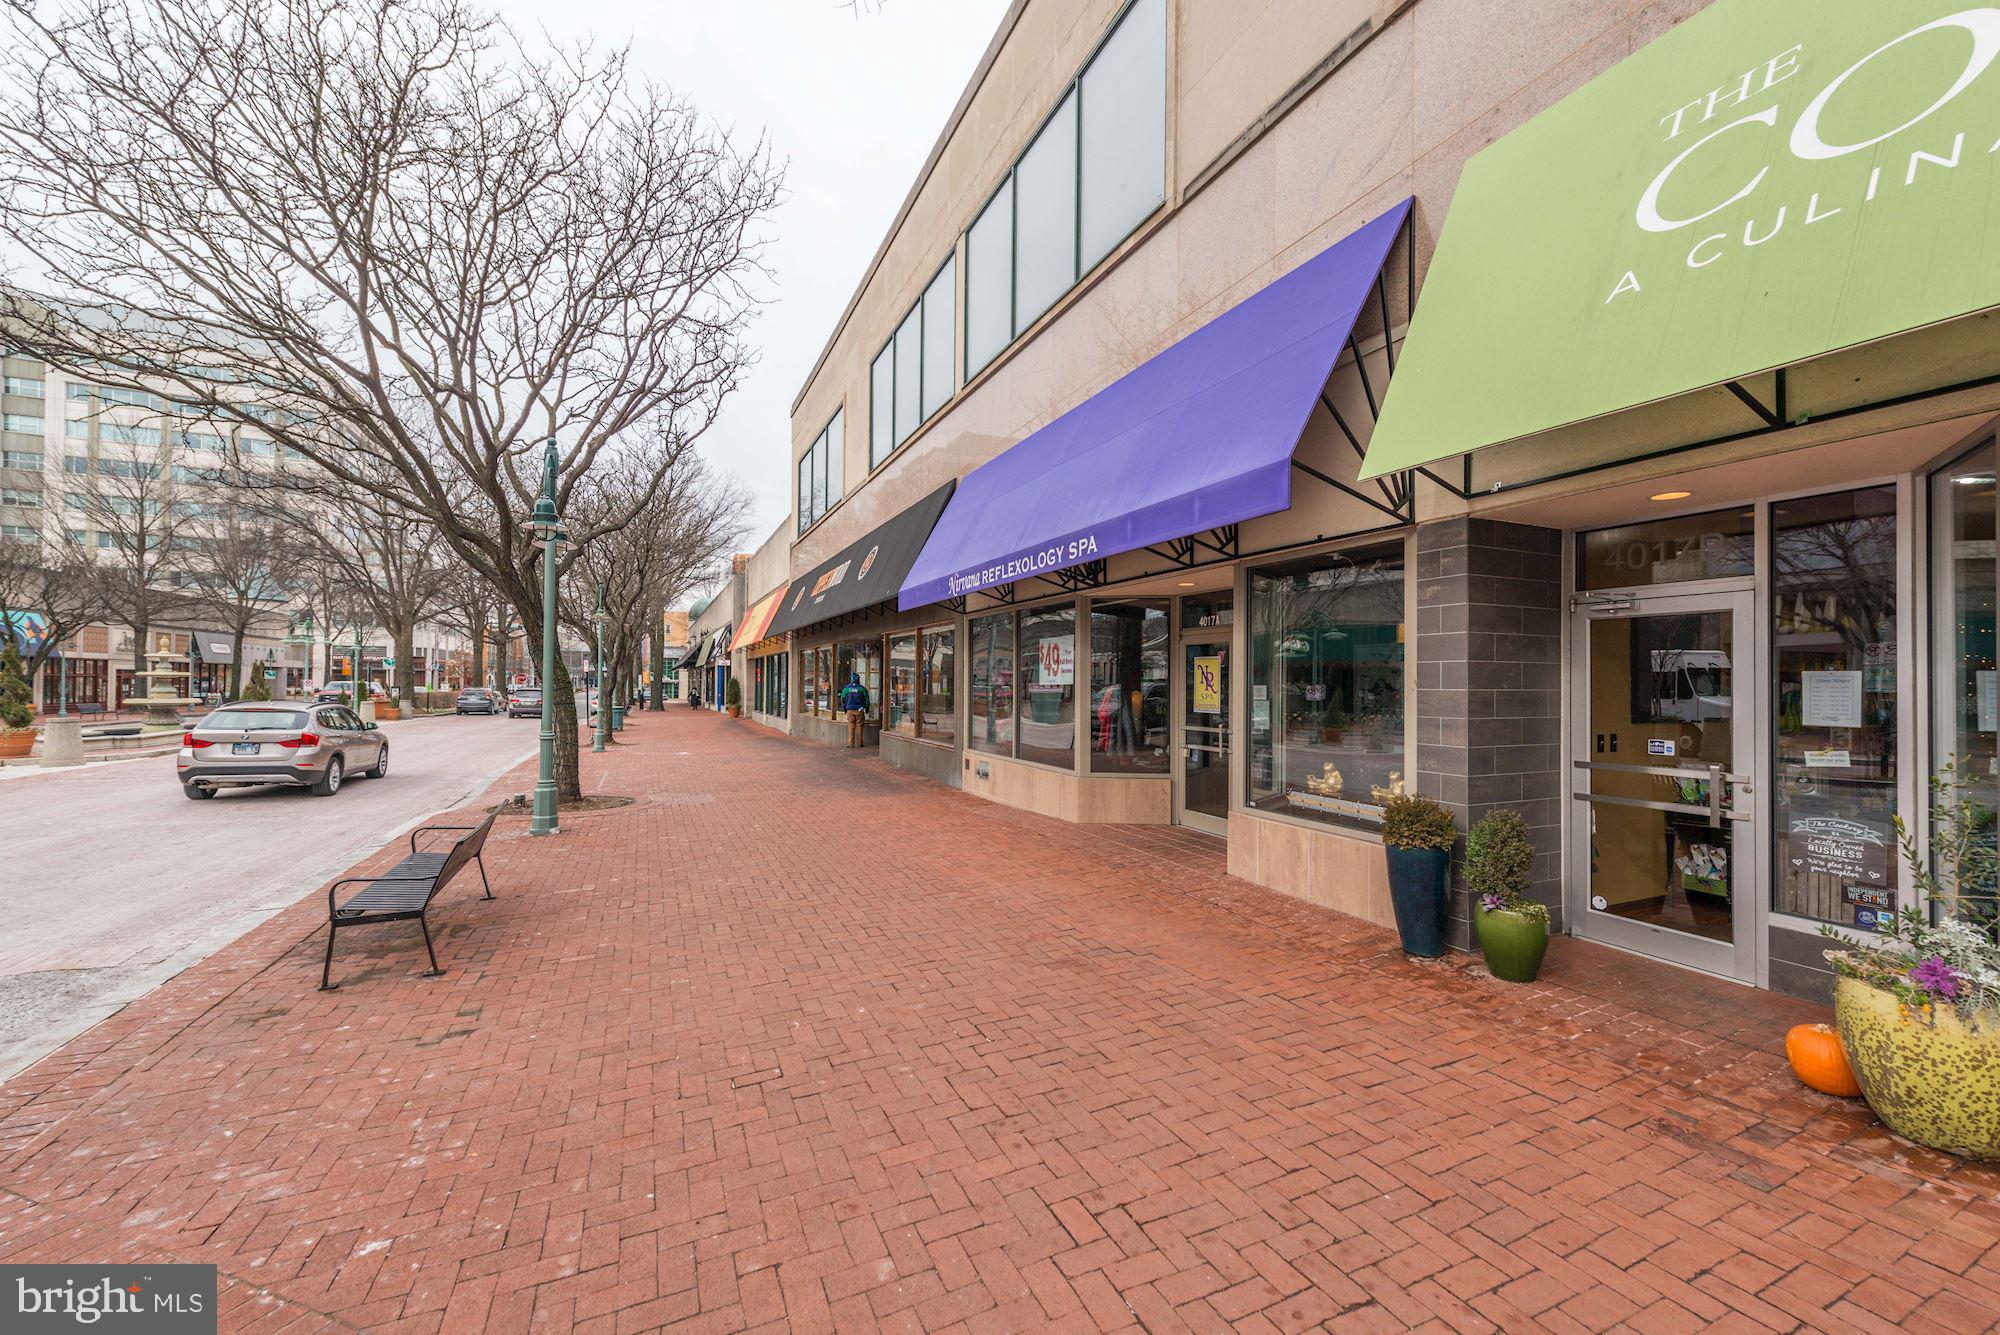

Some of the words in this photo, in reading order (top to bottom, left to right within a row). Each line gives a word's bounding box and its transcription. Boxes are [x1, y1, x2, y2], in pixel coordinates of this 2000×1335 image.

[1658, 43, 1802, 142] THE
[1605, 270, 1641, 304] A
[948, 571, 981, 596] Nirvana
[982, 545, 1064, 584] REFLEXOLOGY
[1068, 535, 1098, 560] SPA
[1199, 615, 1220, 627] 4017A
[1040, 643, 1060, 676] $49
[1828, 821, 1864, 834] Cookery
[1808, 837, 1836, 848] Locally
[1838, 841, 1865, 851] Owned
[1808, 844, 1863, 859] BUSINESS
[1847, 886, 1888, 898] INDEPENDENT
[1848, 892, 1861, 901] WE
